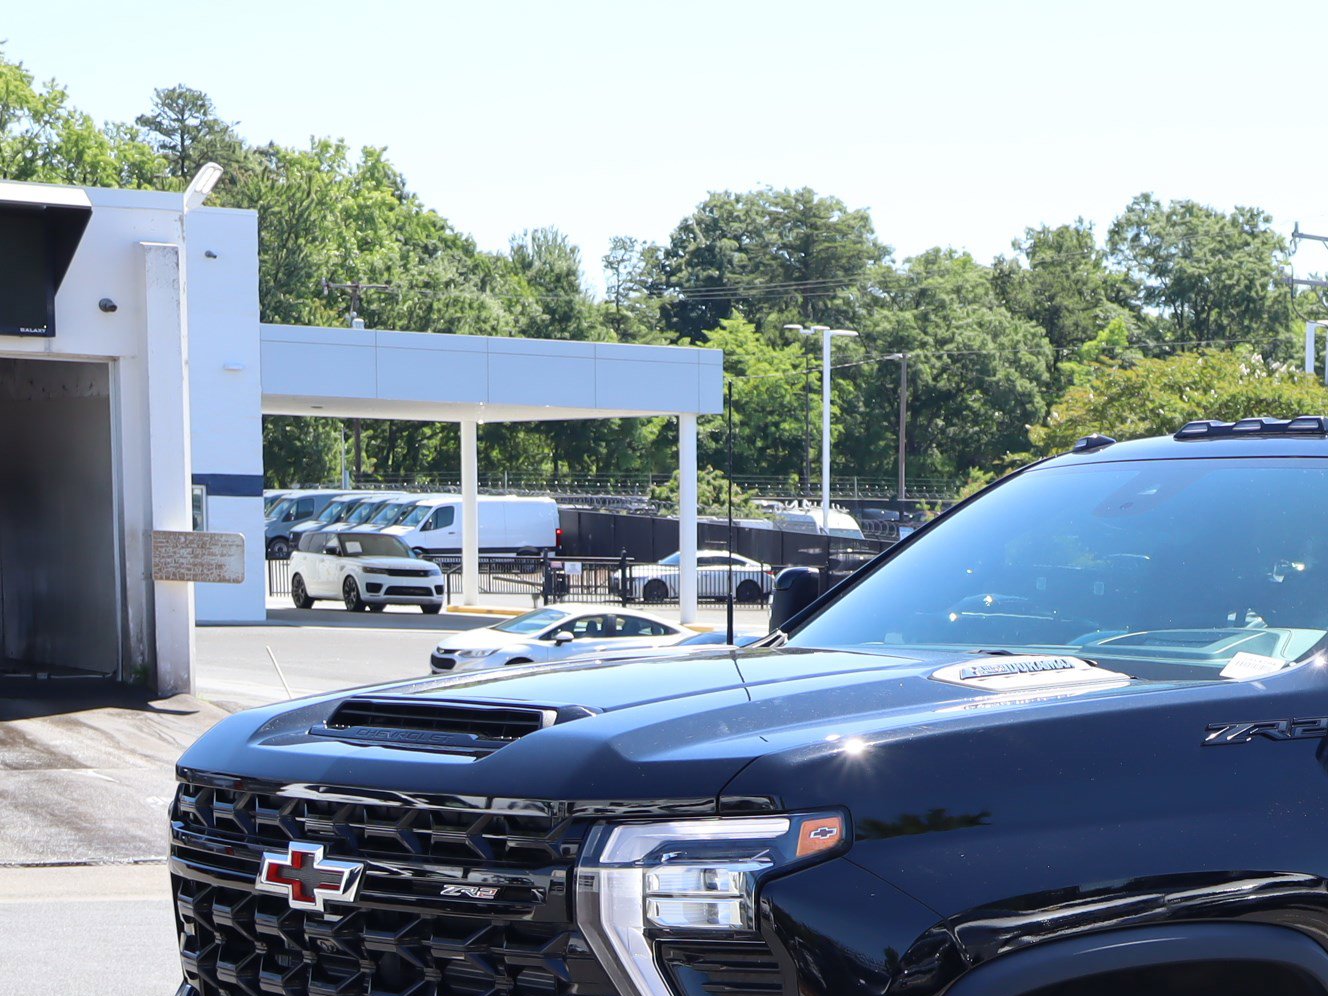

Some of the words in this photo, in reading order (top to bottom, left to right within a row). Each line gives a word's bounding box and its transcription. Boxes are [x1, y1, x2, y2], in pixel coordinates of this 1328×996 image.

[356, 728, 455, 745] CHEVROLET
[1200, 716, 1328, 747] ZR2
[441, 884, 500, 900] ZR2
